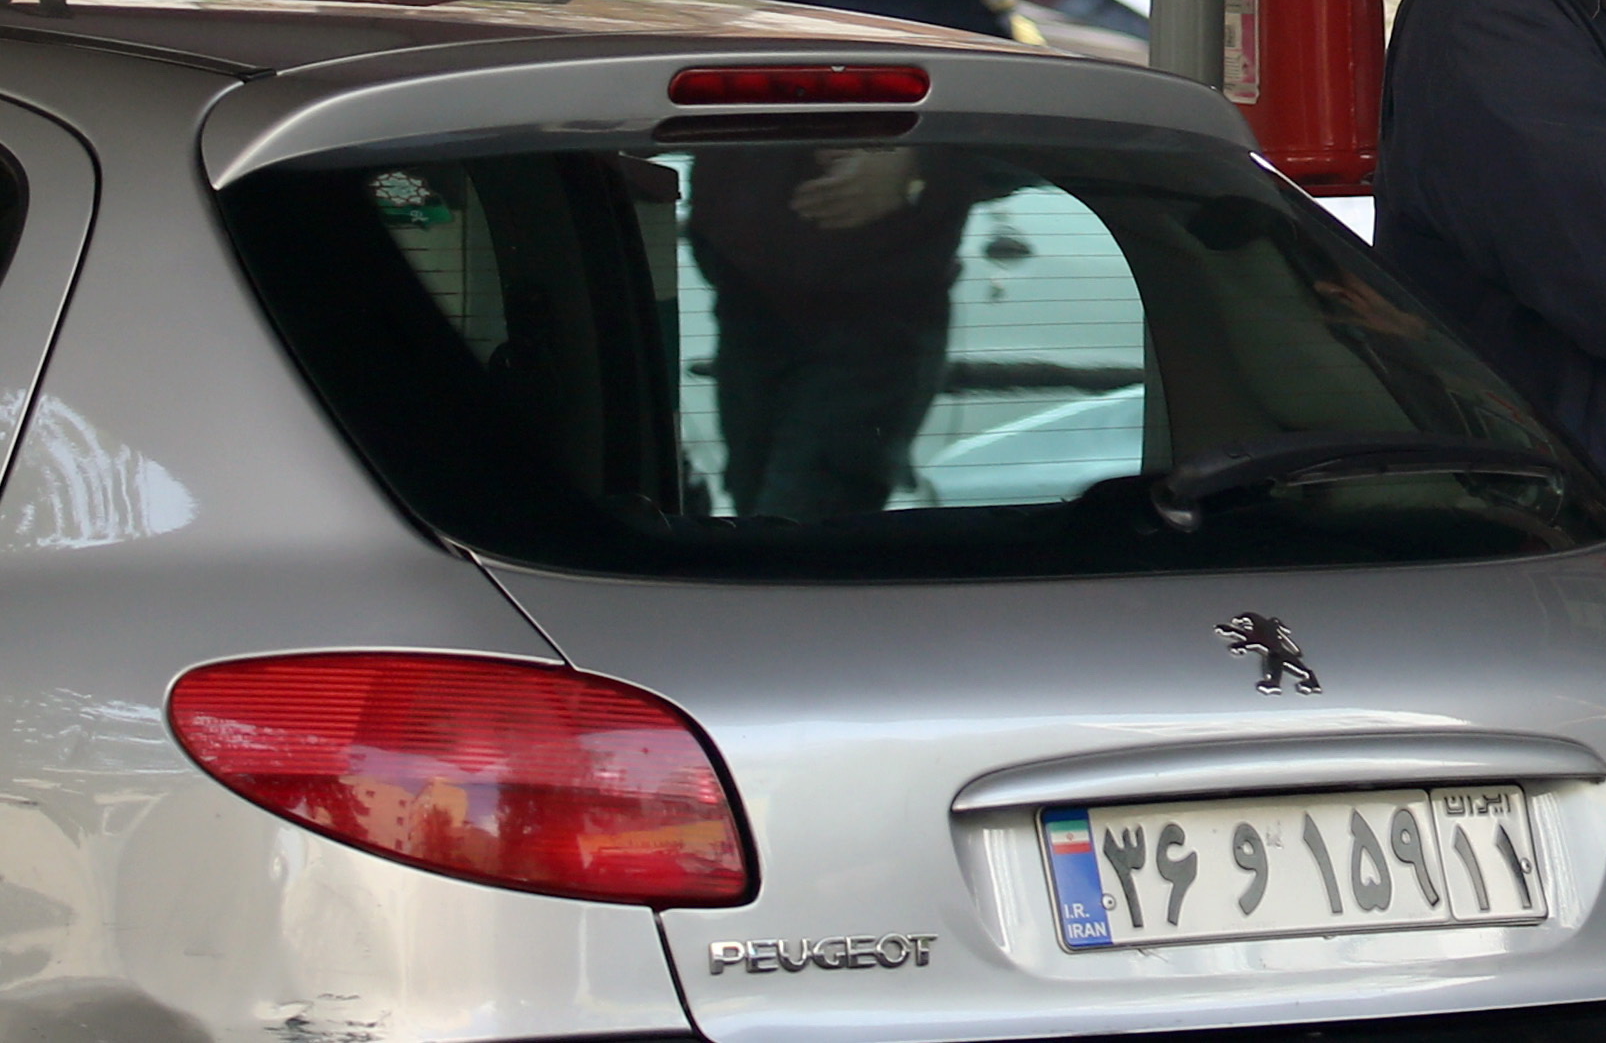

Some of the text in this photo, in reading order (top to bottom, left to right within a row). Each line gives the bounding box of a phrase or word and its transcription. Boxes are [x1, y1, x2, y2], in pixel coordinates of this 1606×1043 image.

[1443, 793, 1512, 818] ایران
[1103, 824, 1199, 928] ۳۶
[1303, 807, 1440, 915] ۱۵۹
[1454, 822, 1532, 912] ۱۱
[1065, 903, 1091, 920] I.R.
[1068, 920, 1107, 939] IRAN
[708, 934, 938, 976] PEUGEOT
